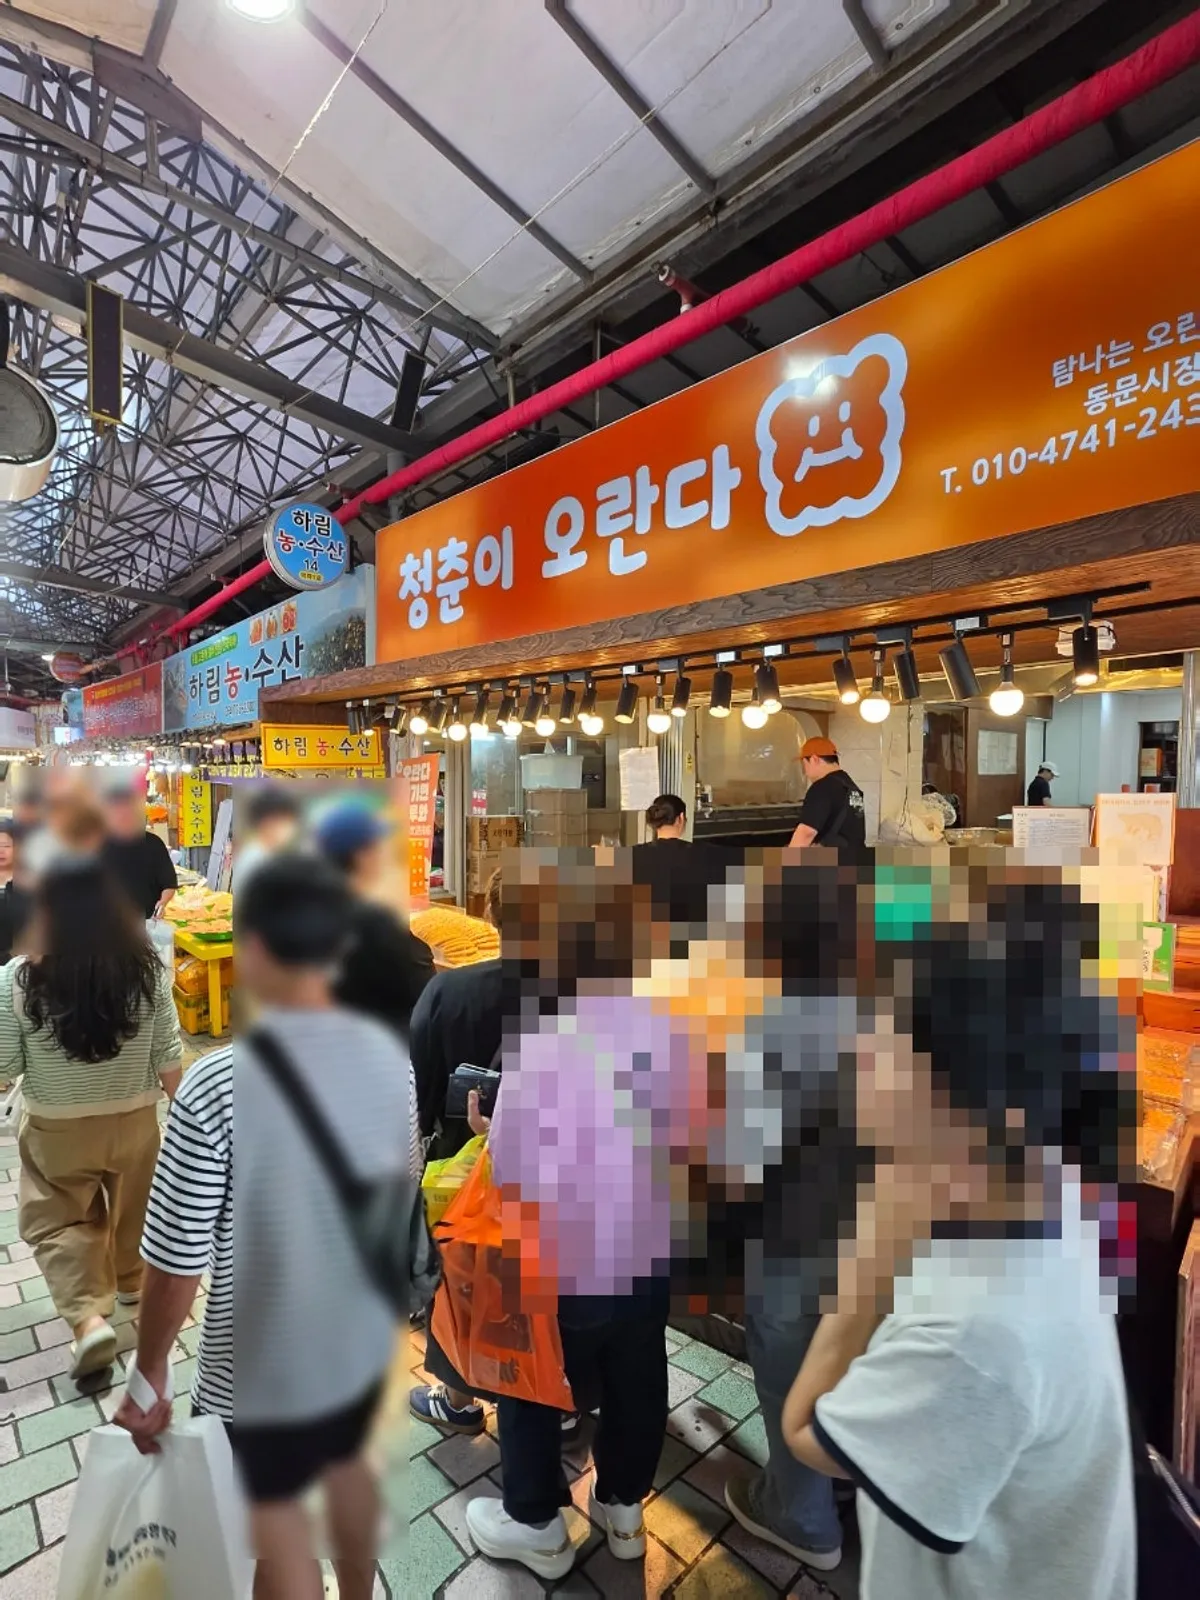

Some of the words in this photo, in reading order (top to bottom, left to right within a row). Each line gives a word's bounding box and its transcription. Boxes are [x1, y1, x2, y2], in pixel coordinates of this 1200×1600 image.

[1052, 340, 1134, 388] 탐나는
[1083, 352, 1200, 416] 동문시장
[940, 466, 962, 493] T.
[292, 509, 331, 537] 하림
[398, 526, 514, 630] 청춘이
[541, 444, 741, 576] 오란다
[304, 559, 318, 571] 14
[273, 737, 307, 757] 하림
